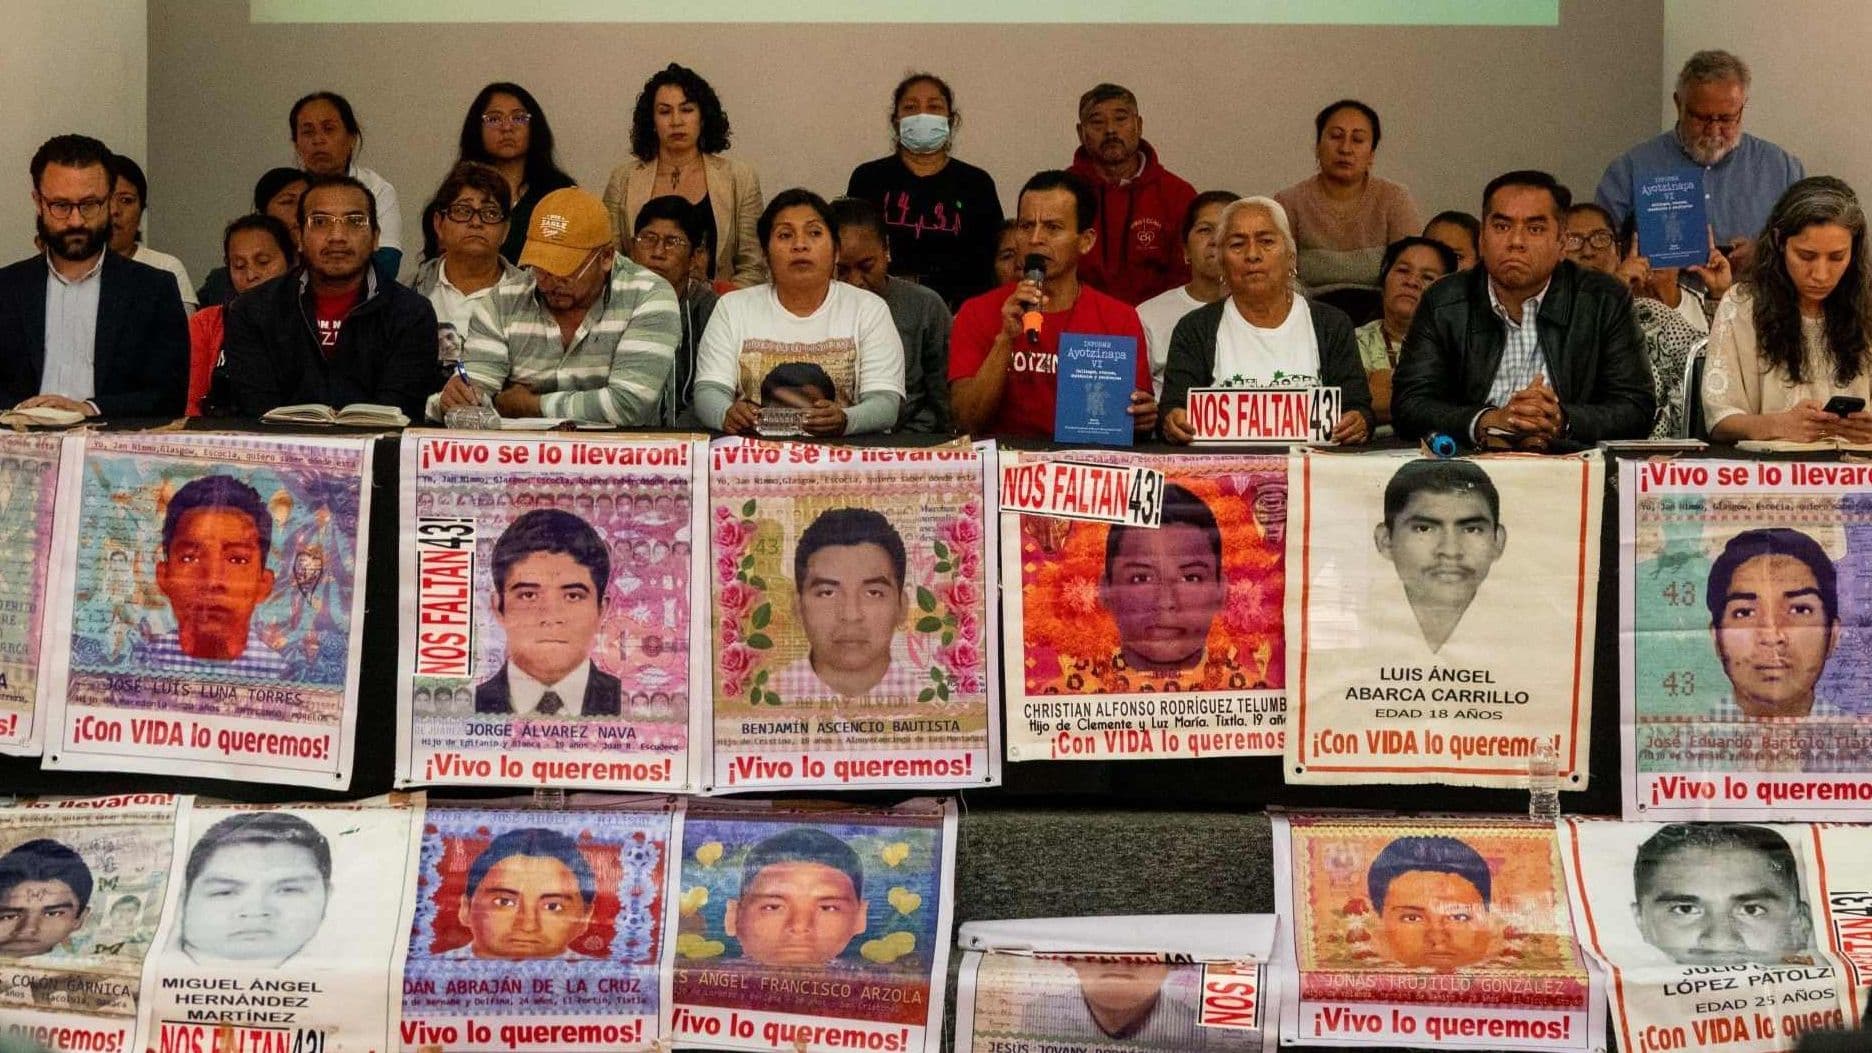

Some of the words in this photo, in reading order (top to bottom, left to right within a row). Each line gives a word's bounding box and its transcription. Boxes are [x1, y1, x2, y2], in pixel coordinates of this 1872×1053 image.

[1067, 346, 1127, 361] Ayotzinapa
[1190, 393, 1230, 438] NOS
[1237, 393, 1308, 437] FALTAN
[422, 440, 490, 469] ¡Vivo
[498, 445, 529, 464] se
[538, 442, 562, 465] lo
[571, 443, 688, 467] llevaron!
[1002, 464, 1047, 510] NOS
[1052, 466, 1130, 517] FALTAN
[1641, 461, 1708, 492] ¡Vivo
[1717, 465, 1749, 486] se
[1758, 463, 1782, 486] lo
[1791, 463, 1872, 486] llevar
[422, 550, 469, 625] FALTAN
[1662, 580, 1696, 607] 43
[419, 632, 468, 675] NOS
[1380, 666, 1423, 682] LUIS
[1427, 665, 1496, 684] ÁNGEL
[1662, 670, 1696, 698] 43
[153, 678, 191, 696] LUIS
[200, 684, 238, 700] LUNA
[248, 687, 301, 706] TORRES
[1345, 686, 1426, 702] ABARCA
[1431, 688, 1530, 705] CARRILLO
[1024, 702, 1091, 719] CHRISTIAN
[1096, 701, 1155, 717] ALFONSO
[1160, 696, 1233, 715] RODRÍGUEZ
[1375, 708, 1422, 719] EDAD
[1430, 708, 1449, 719] 18
[1454, 708, 1504, 721] AÑOS
[73, 714, 122, 744] ¡Con
[130, 718, 184, 747] VIDA
[190, 722, 211, 748] lo
[217, 728, 331, 760] queremos!
[466, 723, 512, 738] JORGE
[522, 720, 589, 739] ÁLVAREZ
[598, 725, 637, 740] NAVA
[742, 719, 809, 735] BENJAMÍN
[817, 720, 885, 735] ASCENCIO
[892, 719, 960, 733] BAUTISTA
[1029, 718, 1050, 736] Hijo
[1056, 718, 1071, 731] de
[1077, 717, 1133, 731] Clemente
[1138, 720, 1146, 732] y
[1151, 717, 1169, 730] Luz
[1253, 714, 1263, 726] 19
[1051, 730, 1095, 759] ¡Con
[1104, 729, 1154, 755] VIDA
[1162, 728, 1180, 753] lo
[1313, 728, 1358, 758] ¡Con
[1365, 729, 1419, 755] VIDA
[1424, 730, 1444, 756] lo
[1450, 733, 1561, 761] querem!
[1648, 734, 1681, 749] José
[1690, 734, 1752, 750] Eduardo
[1761, 735, 1825, 750] Bartolo
[425, 753, 491, 781] ¡Vivo
[500, 755, 522, 777] lo
[532, 758, 672, 784] queremos!
[728, 755, 793, 785] ¡Vivo
[802, 755, 825, 778] lo
[834, 753, 972, 783] queremos!
[1652, 776, 1715, 806] ¡Vivo
[1725, 776, 1748, 800] lo
[162, 977, 244, 991] MIGUEL
[250, 977, 323, 993] ÁNGEL
[445, 975, 522, 995] ABRAJÁN
[533, 978, 553, 994] DE
[566, 978, 587, 993] LA
[598, 978, 641, 993] CRUZ
[760, 977, 851, 998] FRANCISCO
[861, 987, 922, 1005] ARZOLA
[1390, 975, 1471, 992] TRUJILLO
[1663, 977, 1739, 996] LÓPEZ
[175, 992, 310, 1008] HERNÁNDEZ
[1204, 982, 1255, 1027] NOS
[1695, 998, 1748, 1014] EDAD
[1755, 995, 1776, 1008] 25
[1782, 987, 1836, 1005] AÑOS
[187, 1007, 296, 1023] MARTÍNEZ
[1314, 1006, 1382, 1037] ¡Vivo
[1392, 1009, 1416, 1035] lo
[1425, 1014, 1571, 1041] queremos!
[160, 1024, 204, 1053] NOS
[467, 1018, 491, 1043] lo
[500, 1018, 643, 1049] queremos!
[730, 1013, 754, 1039] lo
[763, 1021, 909, 1051] queremos!
[1639, 1020, 1687, 1053] ¡Con
[1691, 1014, 1750, 1046] VIDA
[1754, 1012, 1776, 1040] lo
